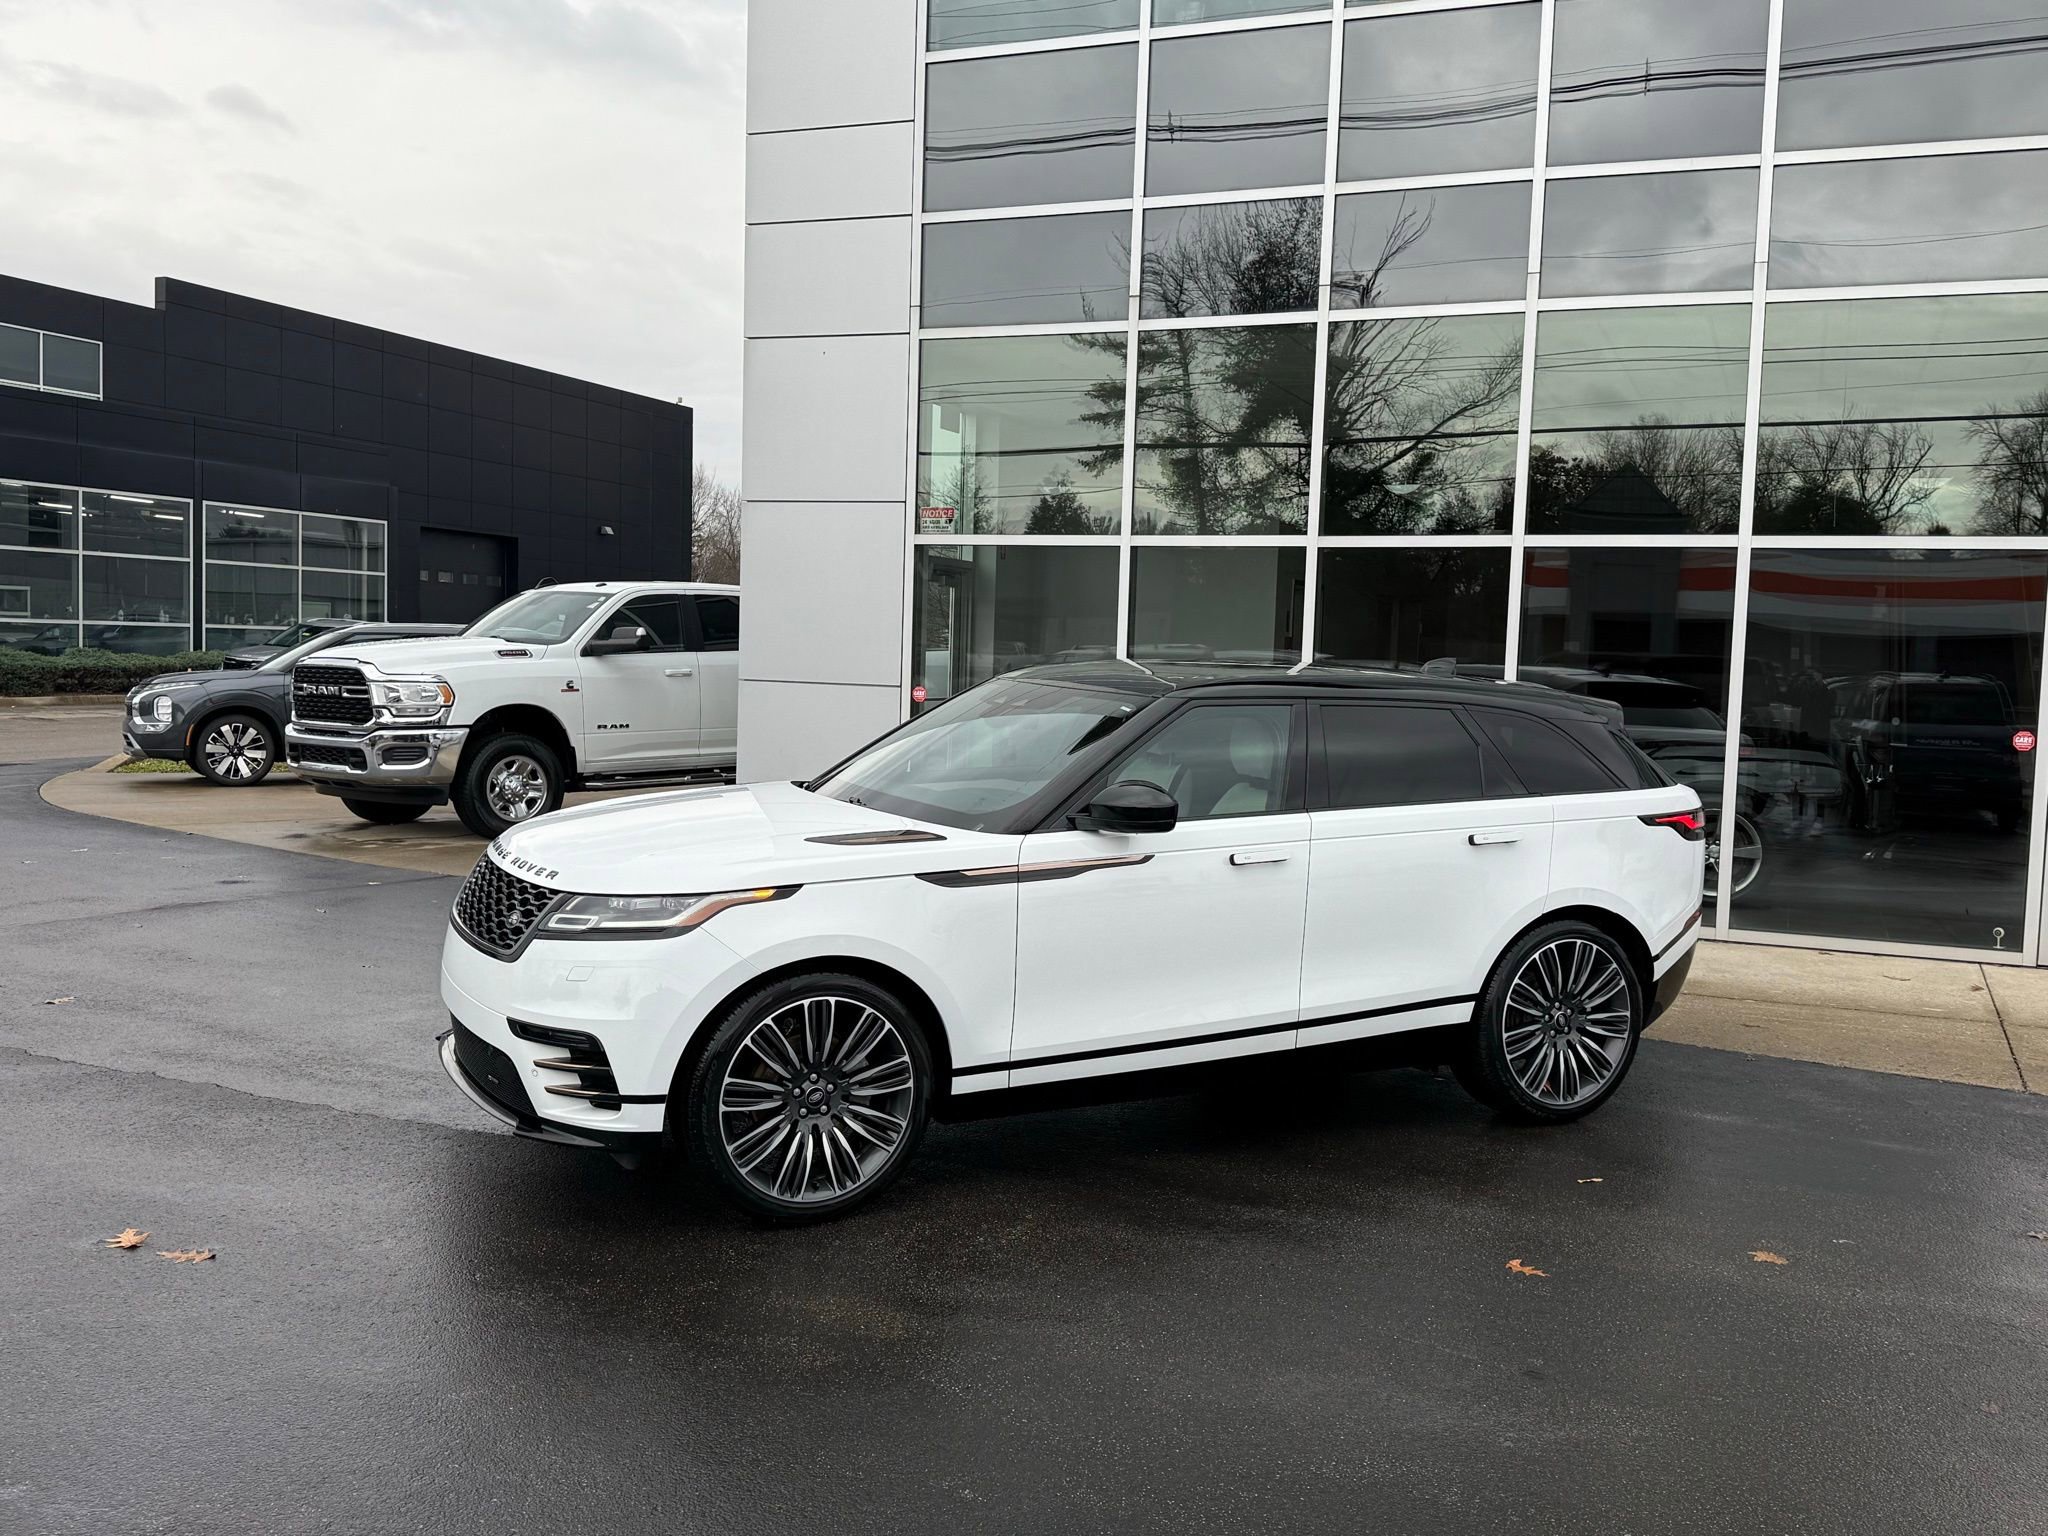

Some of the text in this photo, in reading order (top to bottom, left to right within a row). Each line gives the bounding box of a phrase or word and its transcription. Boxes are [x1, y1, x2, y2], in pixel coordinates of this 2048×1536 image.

[922, 509, 953, 518] NOTICE
[304, 685, 340, 696] RAM
[2015, 736, 2033, 744] CARE
[510, 856, 560, 880] ROVER
